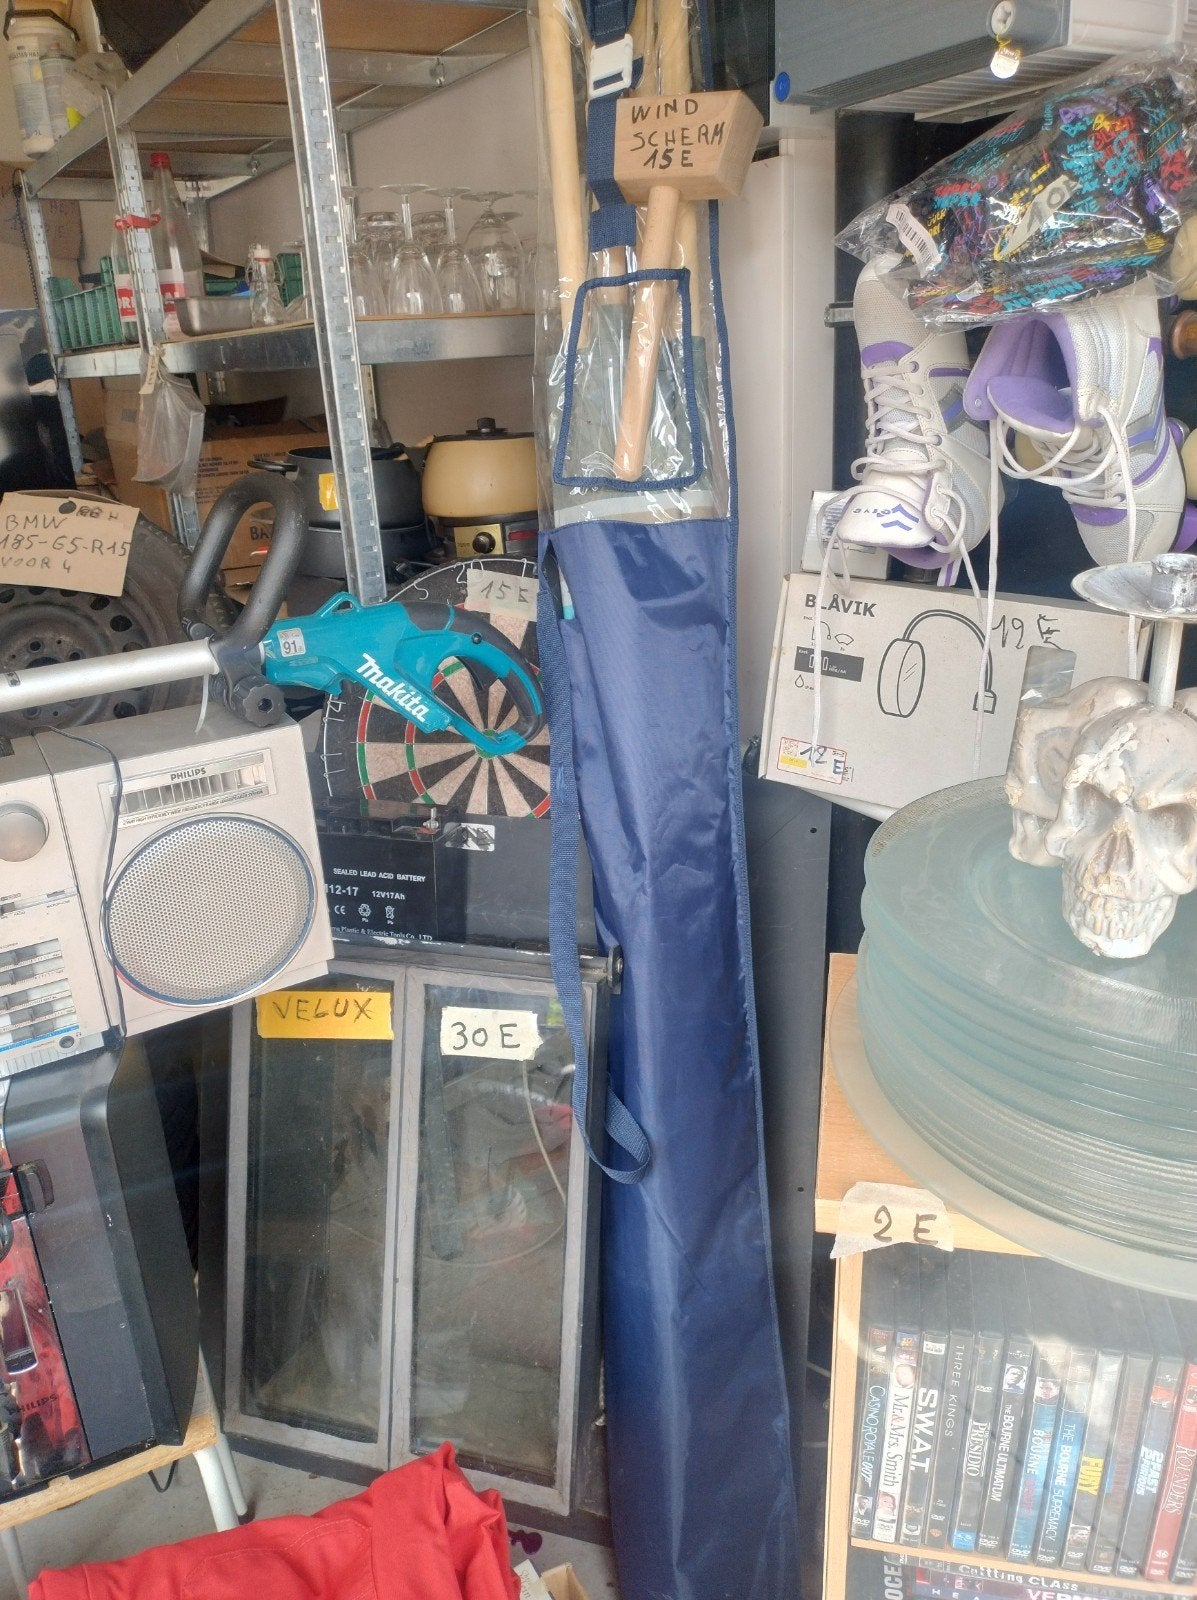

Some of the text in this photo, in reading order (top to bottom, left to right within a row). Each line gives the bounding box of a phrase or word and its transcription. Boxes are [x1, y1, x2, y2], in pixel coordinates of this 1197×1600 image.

[632, 99, 698, 124] WIND
[630, 122, 725, 151] SCHERM
[6, 515, 68, 531] BMW
[63, 560, 71, 573] 4
[481, 580, 529, 604] 15 E
[805, 593, 877, 618] BÅVIK
[284, 640, 297, 654] 91
[170, 767, 206, 781] PHILIPS
[333, 867, 357, 876] SEALED
[360, 870, 376, 878] LEAD
[397, 874, 426, 882] BATTERY
[372, 890, 405, 900] 12V17Ah
[451, 1022, 520, 1050] 30 E
[873, 1205, 938, 1244] 2 E
[866, 1385, 886, 1426] CASINO
[945, 1345, 964, 1437] THREE KINGS
[863, 1425, 878, 1461] ROYALE
[966, 1420, 987, 1476] PRESIDIO
[1063, 1424, 1076, 1441] THE
[991, 1405, 1015, 1502] THE BOURNE ULTIMATUM
[1027, 1429, 1044, 1475] BOURNE
[1055, 1445, 1072, 1486] BOURNE
[883, 1451, 904, 1487] Smith
[1077, 1456, 1104, 1495] FURY
[1165, 1444, 1196, 1514] ROUNDERS
[1045, 1489, 1064, 1541] SUPREMACY
